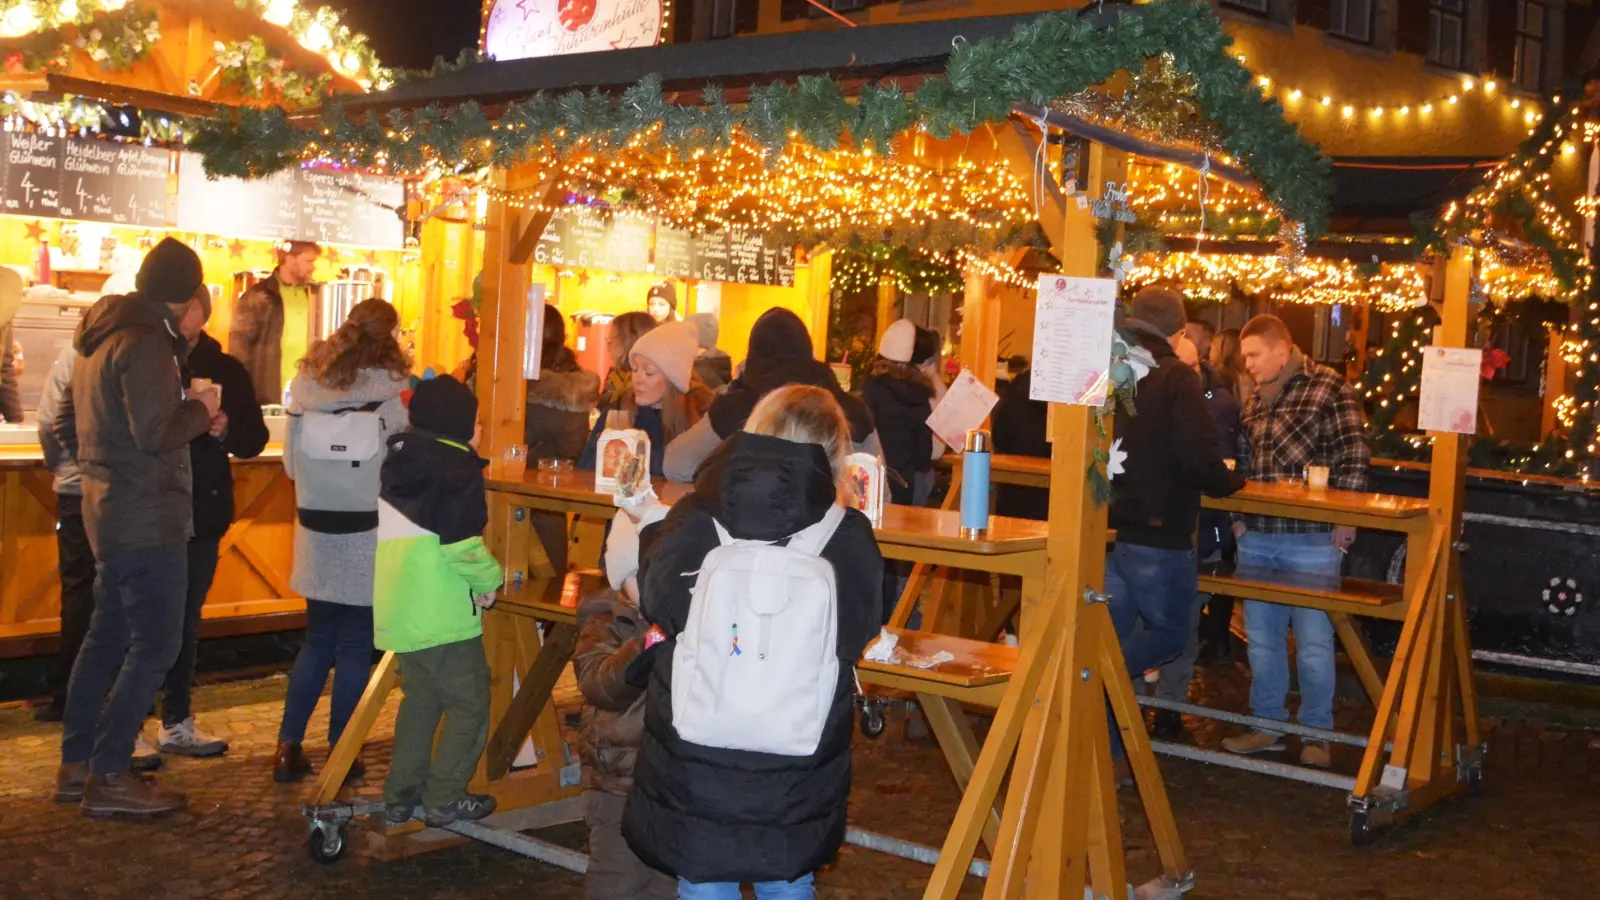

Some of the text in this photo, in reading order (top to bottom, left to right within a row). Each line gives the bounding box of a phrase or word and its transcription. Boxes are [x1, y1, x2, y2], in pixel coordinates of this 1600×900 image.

[11, 133, 54, 153] Weißer
[66, 139, 116, 163] Heidelbeer
[9, 150, 56, 169] Glühwein
[64, 156, 110, 176] Glühwein
